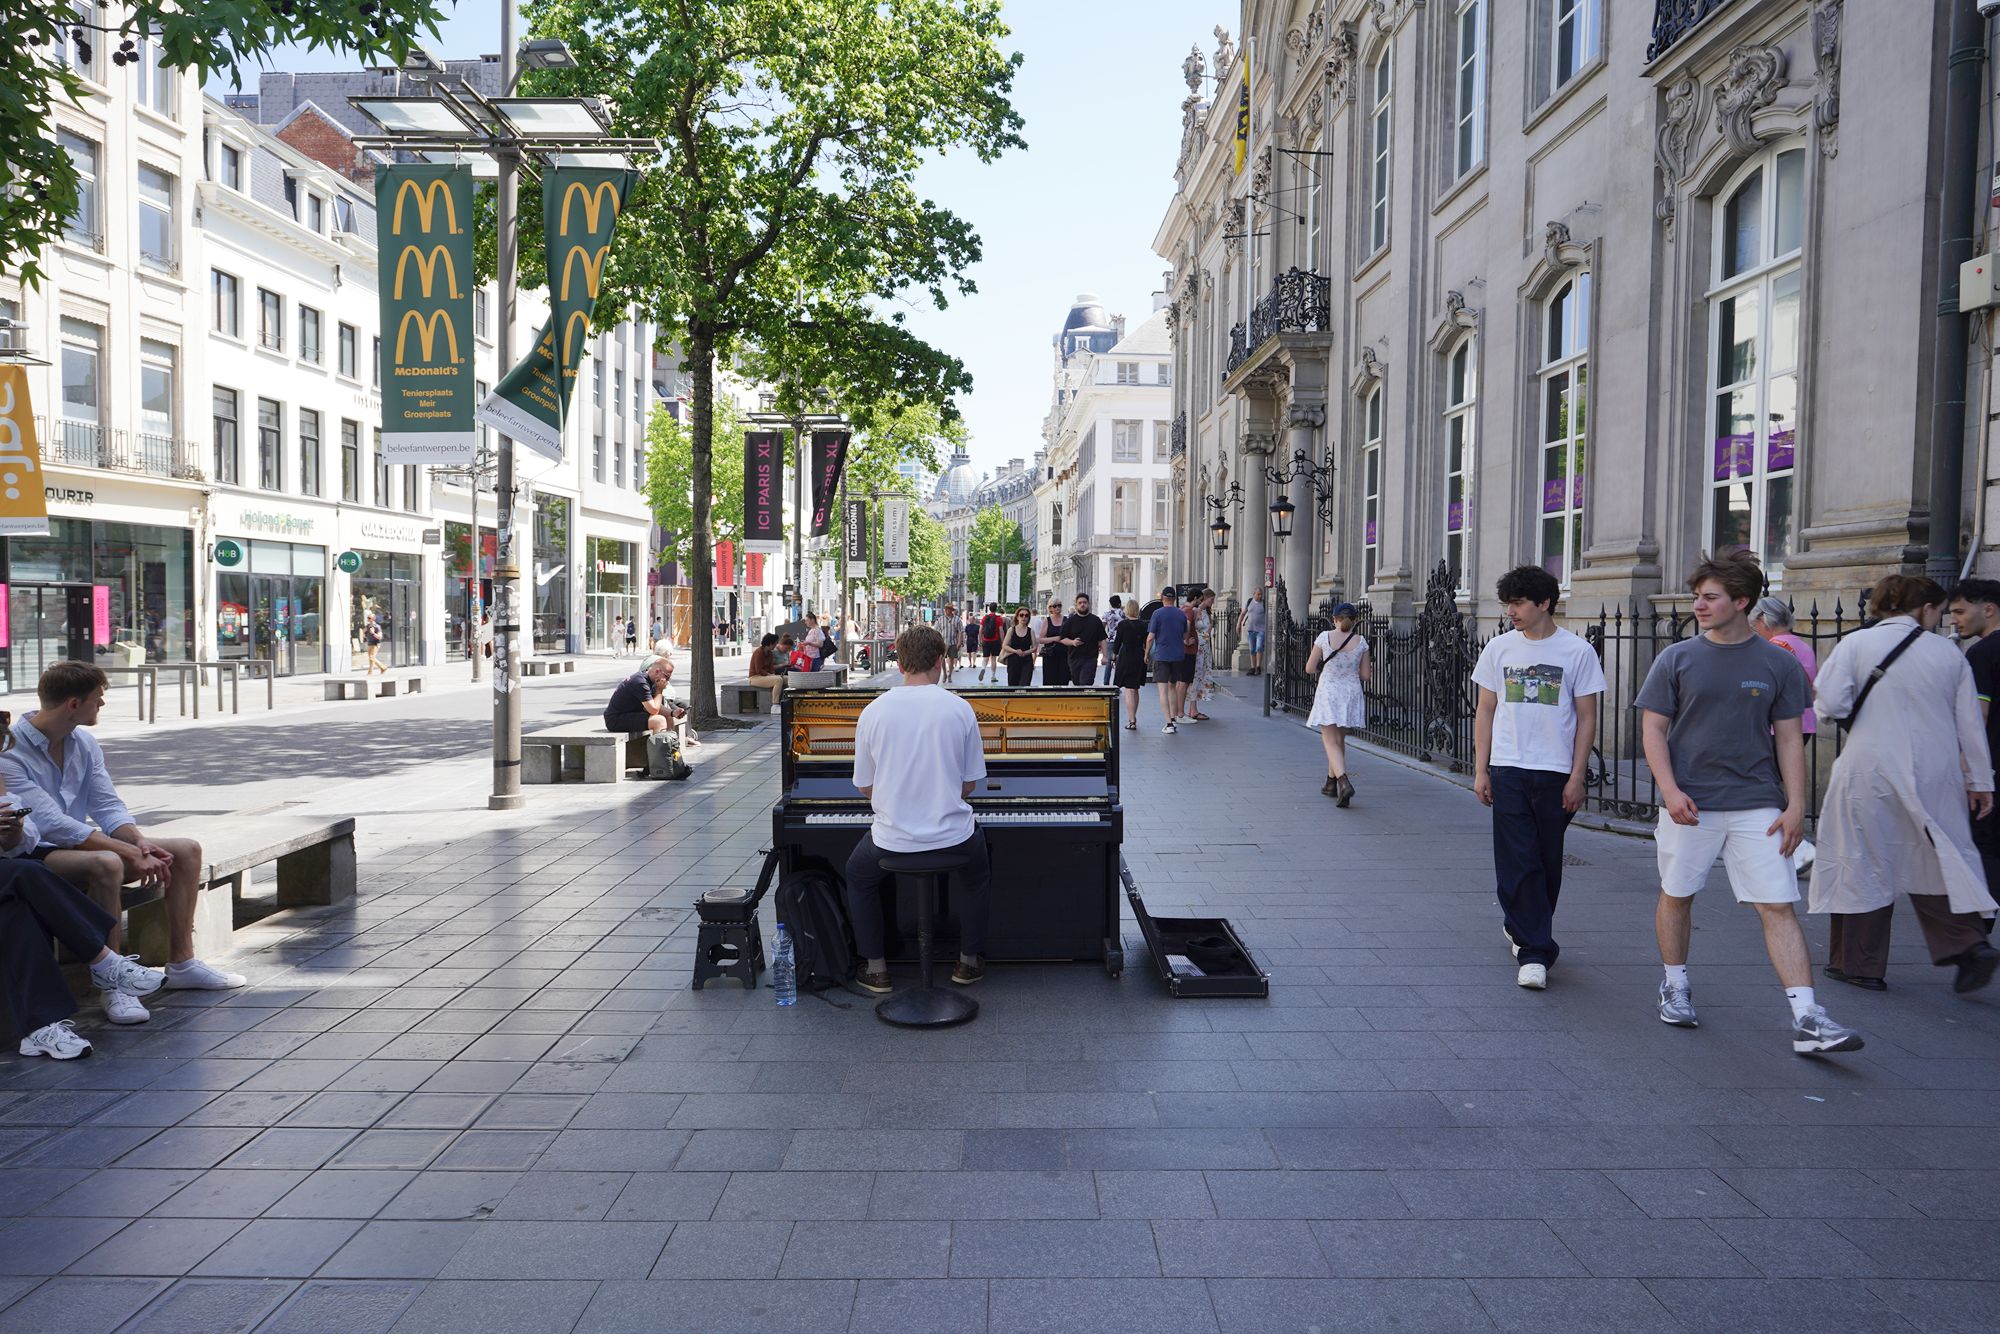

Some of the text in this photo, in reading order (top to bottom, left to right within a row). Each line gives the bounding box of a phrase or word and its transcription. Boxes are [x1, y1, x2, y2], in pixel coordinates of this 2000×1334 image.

[394, 366, 459, 376] McDonald's
[401, 389, 454, 398] Teniersplaats
[419, 399, 436, 407] Meir
[403, 410, 452, 419] Groenplaats
[387, 443, 470, 454] beleefantwerpen.be
[758, 439, 770, 530] ICI PARIS XL
[815, 507, 825, 527] ICI
[826, 440, 838, 458] XL
[45, 487, 94, 503] OURIR
[850, 503, 858, 557] CALZEDONIA
